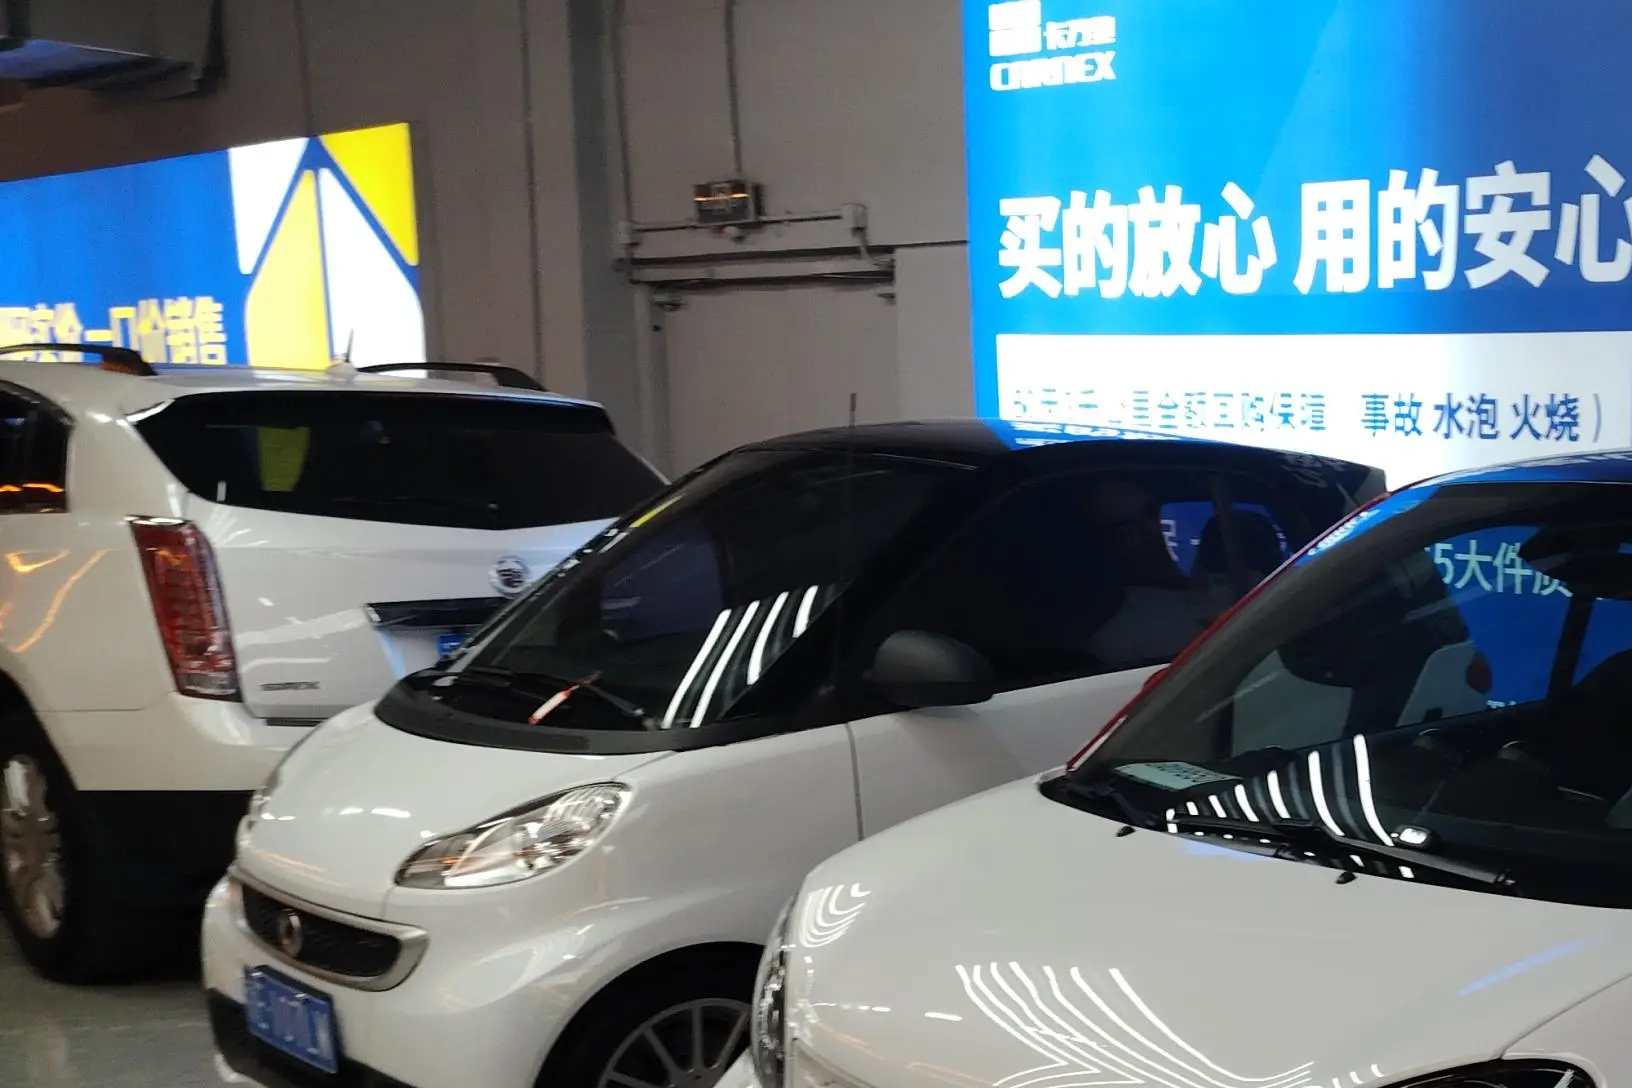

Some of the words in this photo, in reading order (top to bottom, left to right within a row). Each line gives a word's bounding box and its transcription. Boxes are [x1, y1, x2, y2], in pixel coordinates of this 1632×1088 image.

[998, 180, 1278, 299] 买的放心
[1360, 392, 1423, 437] 事故
[1432, 392, 1500, 440] 水泡
